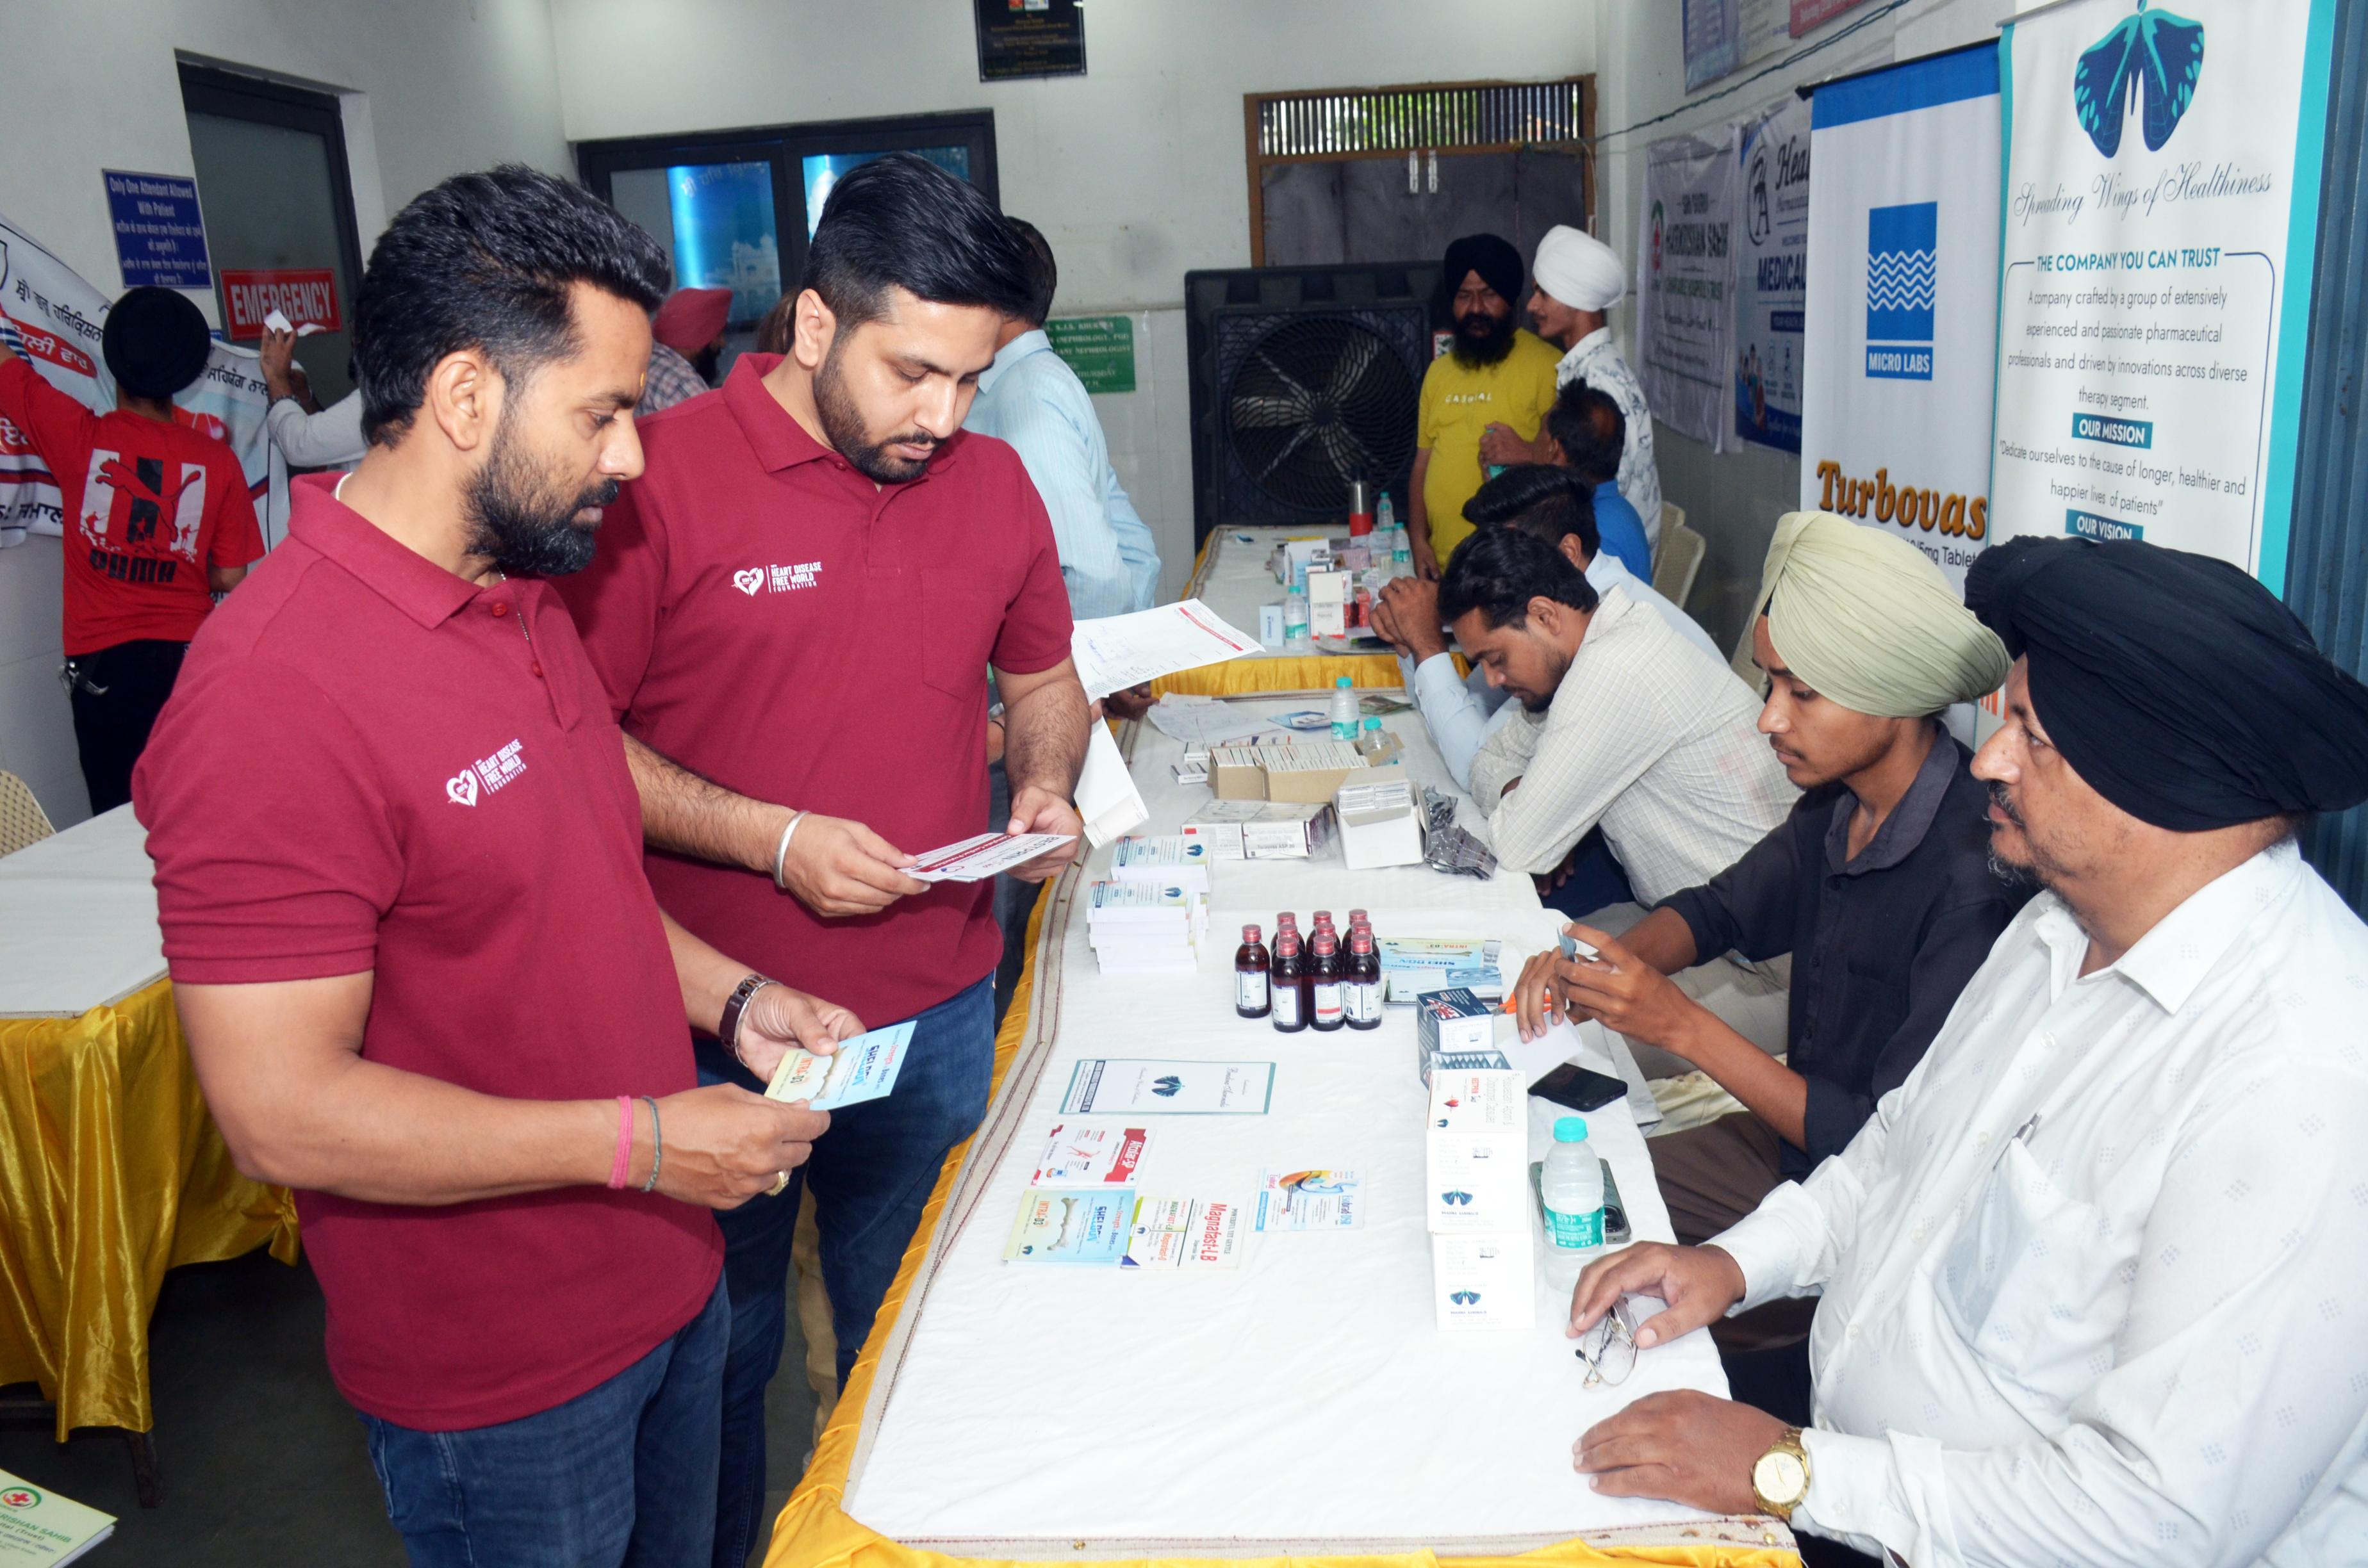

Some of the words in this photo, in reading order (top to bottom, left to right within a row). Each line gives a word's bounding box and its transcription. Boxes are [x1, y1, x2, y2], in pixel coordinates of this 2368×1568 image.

[110, 176, 125, 196] Only
[126, 179, 139, 194] One
[140, 180, 169, 197] Attendant
[169, 183, 193, 199] Allowed
[2013, 182, 2084, 227] Spreading
[2091, 172, 2139, 221] Wings
[2142, 170, 2167, 216] of
[2163, 161, 2273, 202] Healthiness
[137, 201, 153, 216] With
[153, 202, 176, 217] Patient
[2037, 255, 2052, 272] THE
[2057, 252, 2117, 272] COMPANY
[2119, 251, 2144, 270] YOU
[2148, 250, 2176, 270] CAN
[2181, 248, 2220, 268] TRUST
[230, 281, 331, 325] EMERGENCY
[2028, 292, 2033, 305] A
[2034, 289, 2072, 309] company
[2075, 287, 2109, 306] crafted
[2110, 290, 2119, 307] by
[2120, 293, 2125, 305] a
[2127, 290, 2157, 309] group
[2160, 286, 2172, 304] of
[2175, 286, 2228, 310] extensively
[2027, 320, 2078, 339] experienced
[2081, 325, 2099, 339] and
[2101, 325, 2142, 343] passionate
[2146, 323, 2223, 343] pharmaceutical
[1868, 353, 1902, 372] MICRO
[1903, 353, 1930, 373] LABS
[2008, 350, 2051, 369] professionals
[2055, 355, 2075, 370] and
[2078, 353, 2107, 372] driven
[2108, 358, 2116, 377] by
[2118, 359, 2172, 377] innovations
[2175, 363, 2206, 379] across
[2208, 359, 2248, 382] diverse
[2078, 386, 2109, 408] therapy
[2110, 393, 2149, 412] segment.
[2078, 418, 2101, 437] OUR
[2101, 421, 2146, 445] MISSION
[2028, 447, 2076, 466] ourselves
[2078, 454, 2087, 467] to
[2089, 452, 2101, 471] the
[2102, 459, 2123, 476] cause
[2126, 458, 2137, 477] of
[2139, 461, 2175, 486] longer,
[2178, 466, 2221, 492] healthier
[2224, 476, 2246, 496] and
[1817, 459, 1987, 541] Turbovas
[2050, 478, 2089, 502] happier
[2091, 486, 2106, 505] lives
[2109, 491, 2119, 507] of
[2076, 515, 2097, 535] OUR
[2099, 520, 2132, 540] VISION
[90, 548, 177, 583] PUMA
[771, 566, 792, 577] HEART
[794, 562, 823, 573] DISEASE
[772, 576, 789, 586] FREE
[790, 573, 814, 584] WORLD
[773, 581, 817, 592] FOUNDATION
[477, 754, 500, 776] HEART
[497, 739, 523, 762] DISEASE
[484, 767, 503, 787] FREE
[499, 754, 522, 775] WORLD
[884, 1045, 899, 1065] Strength
[877, 1068, 890, 1083] Bones
[1483, 1077, 1499, 1101] Clopidogrel
[1484, 1102, 1499, 1123] Capsules
[1501, 1106, 1515, 1120] Aspirin
[1122, 1140, 1142, 1168] Afcolar-SP
[1269, 1174, 1278, 1189] Esobrad
[1087, 1206, 1107, 1241] SHELDON
[1112, 1210, 1124, 1229] Strength
[1165, 1201, 1179, 1230] MAGNAFAST-LB
[1228, 1208, 1238, 1229] POWERFUL
[1109, 1232, 1118, 1245] Bones
[1199, 1203, 1227, 1261] Magnafast-LB
[1224, 1239, 1233, 1254] GENTLE
[15, 1528, 45, 1540] (Trust)
[40, 1528, 72, 1542] SAHIB
